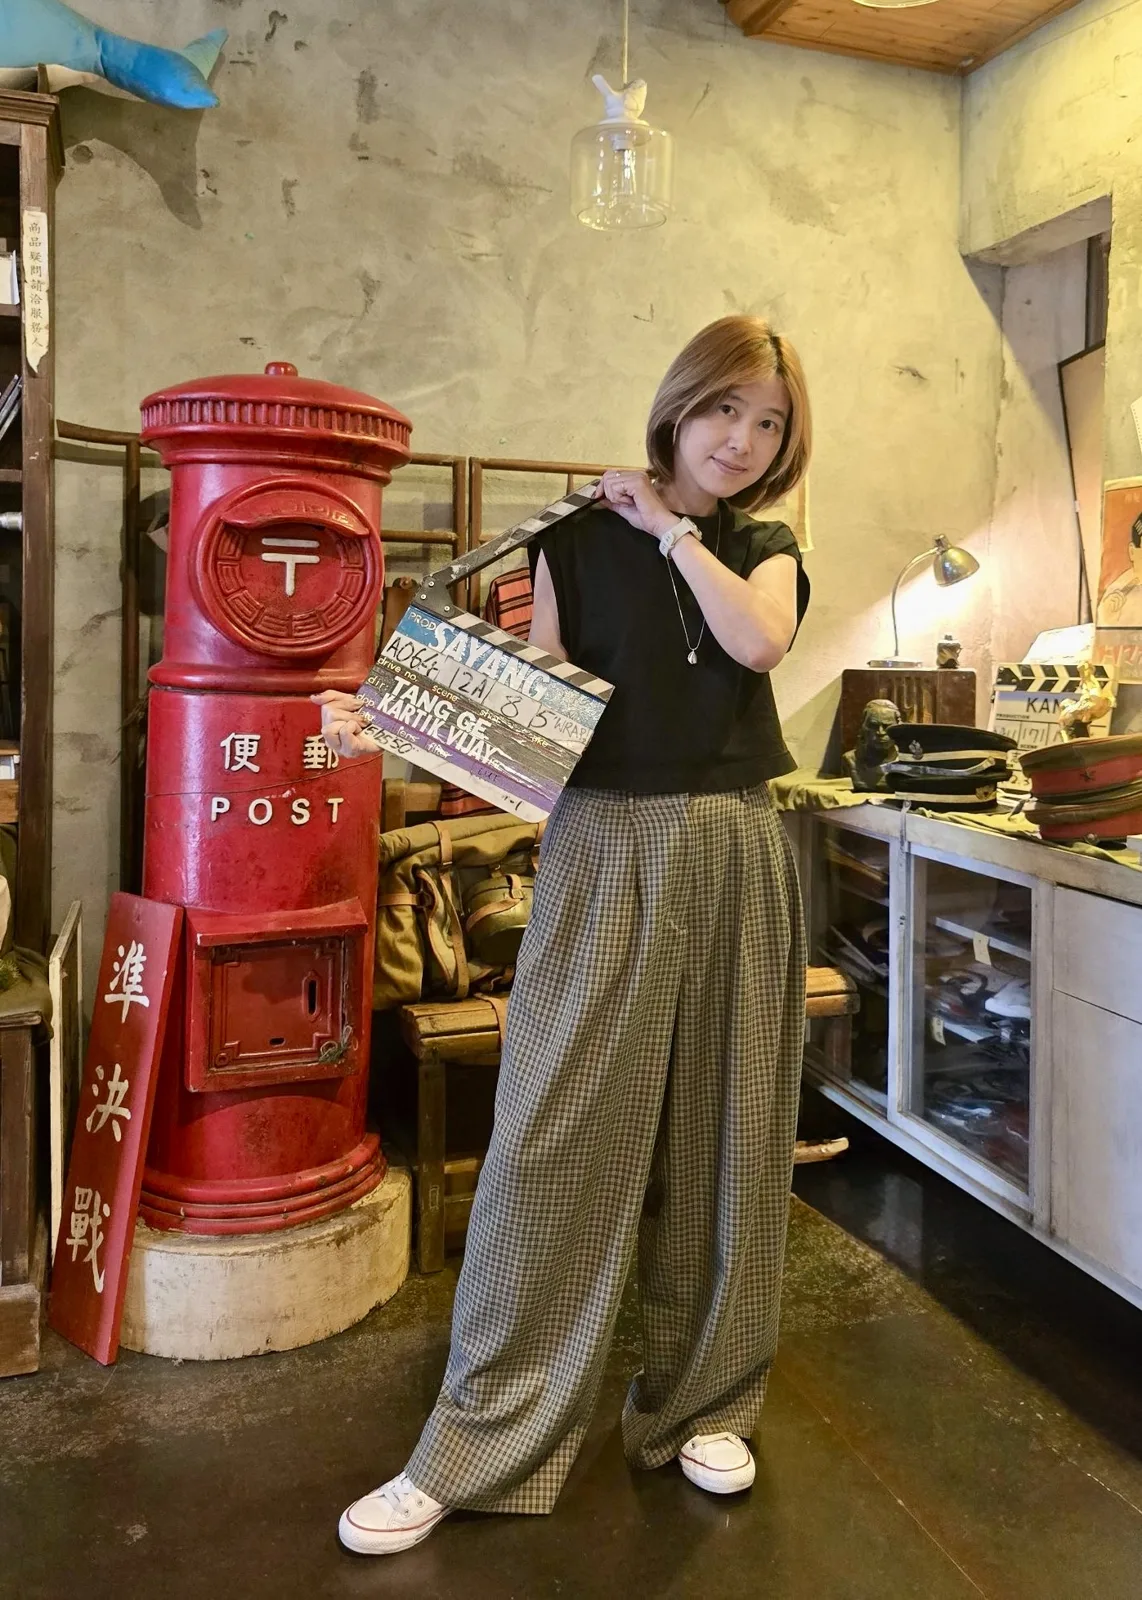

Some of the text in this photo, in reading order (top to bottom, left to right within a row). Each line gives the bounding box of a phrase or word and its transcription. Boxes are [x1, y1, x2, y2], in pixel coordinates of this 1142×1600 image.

[377, 656, 402, 673] drive
[432, 685, 459, 701] scene
[428, 621, 551, 701] SAYANG
[377, 692, 447, 742] KARTIK
[446, 725, 498, 765] VIJAY
[391, 676, 456, 722] TANG
[456, 711, 494, 741] GE
[500, 694, 522, 718] 8
[210, 797, 345, 826] POST
[66, 940, 150, 1293] 準決戰
